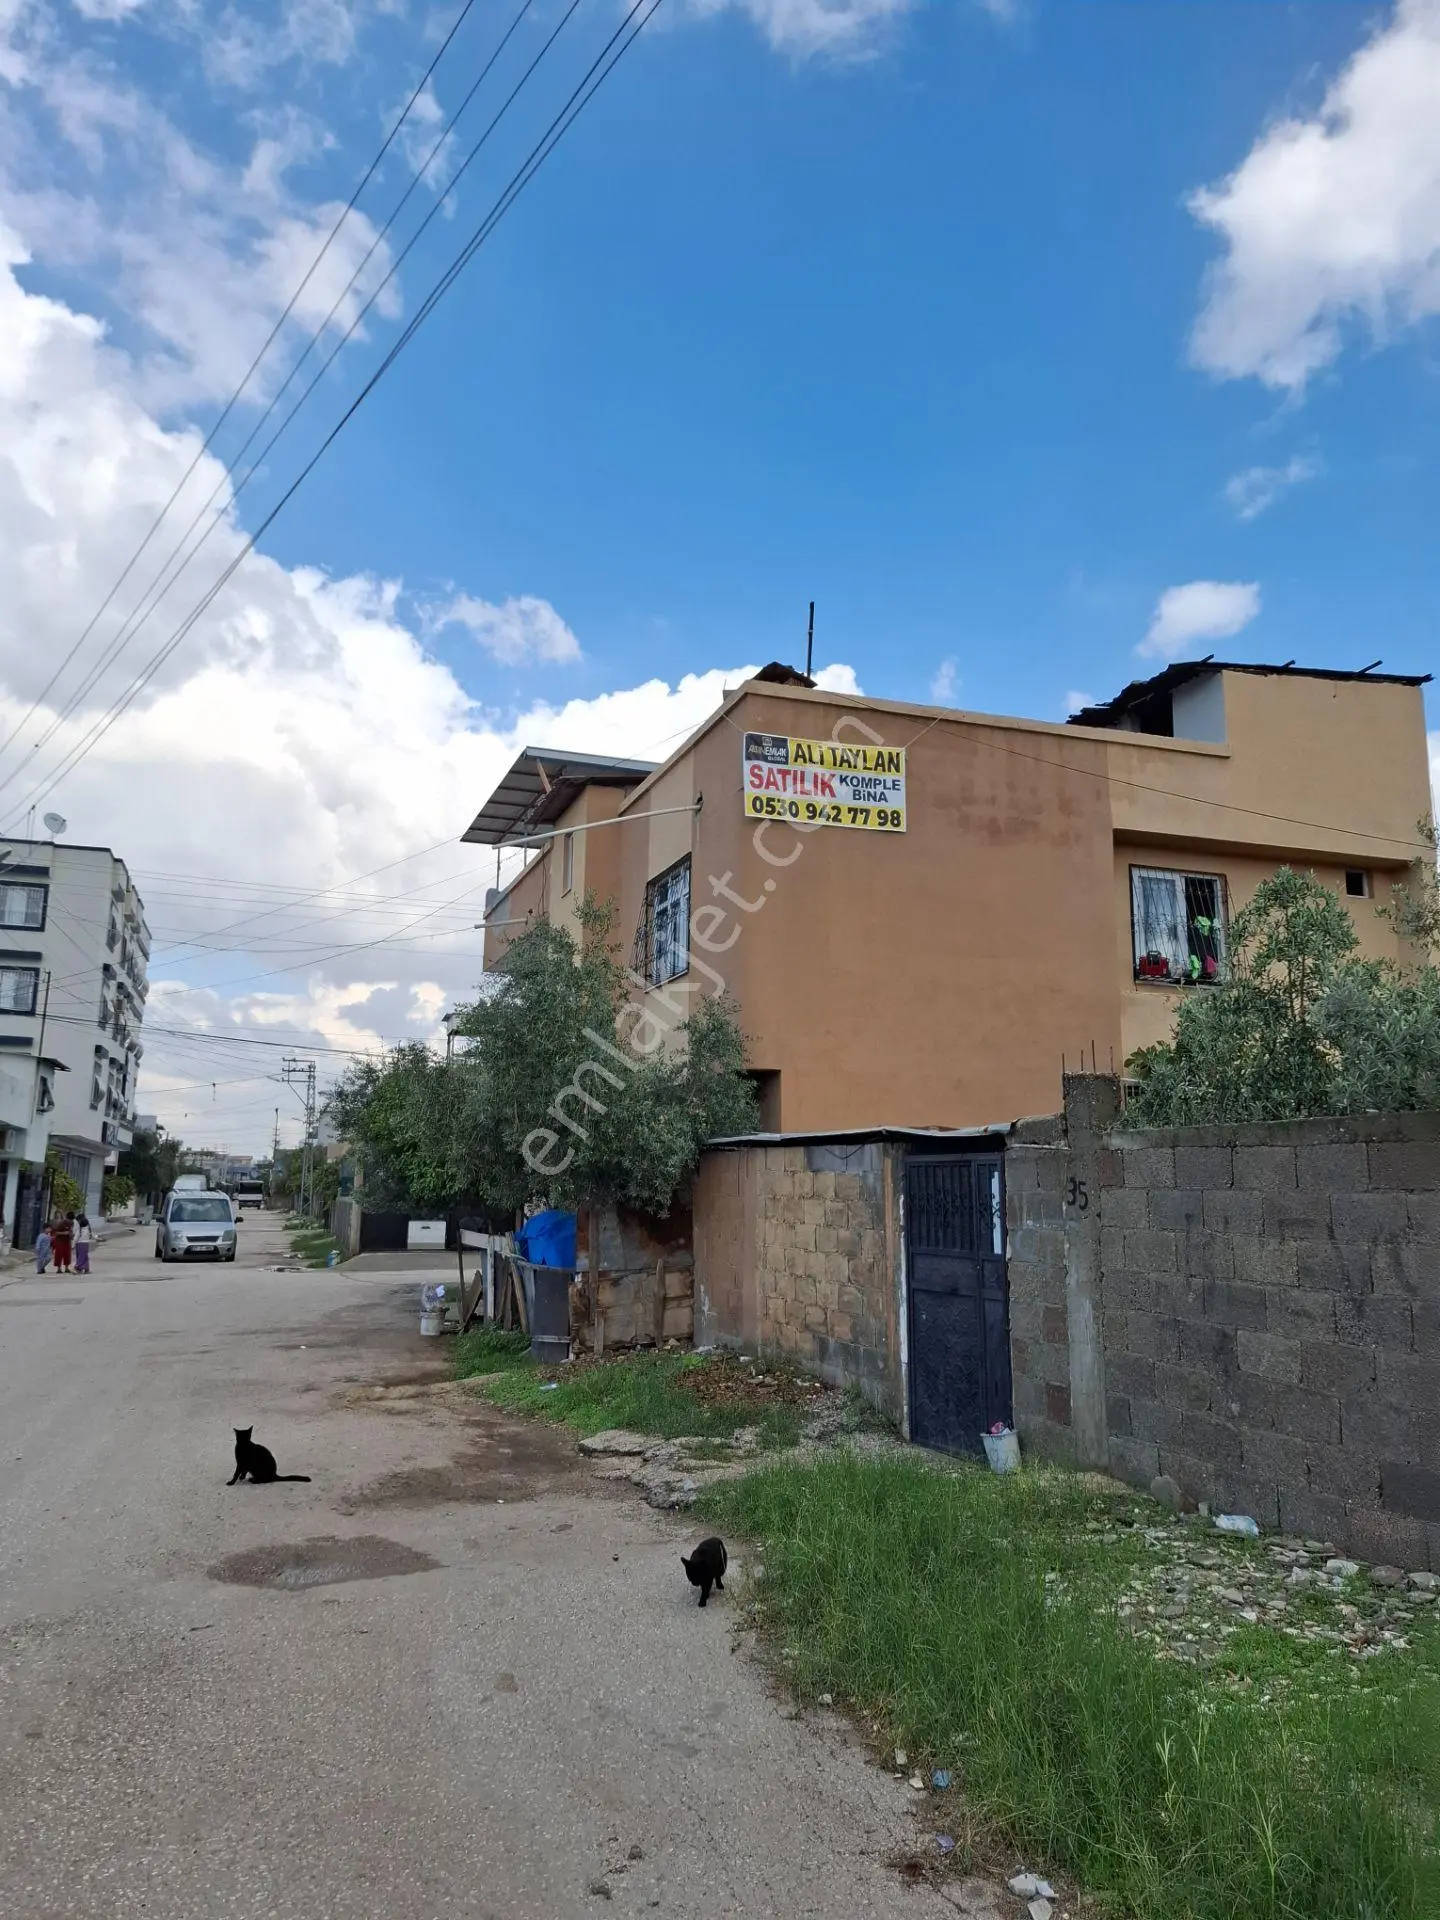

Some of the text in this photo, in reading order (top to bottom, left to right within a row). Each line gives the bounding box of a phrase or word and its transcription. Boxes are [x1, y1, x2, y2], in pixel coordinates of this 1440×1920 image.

[828, 746, 901, 773] TAYLAN
[749, 764, 837, 798] SATILIK
[839, 774, 902, 791] KOMPLE
[752, 796, 901, 828] 0530 942 77 98
[1066, 1176, 1089, 1211] 35
